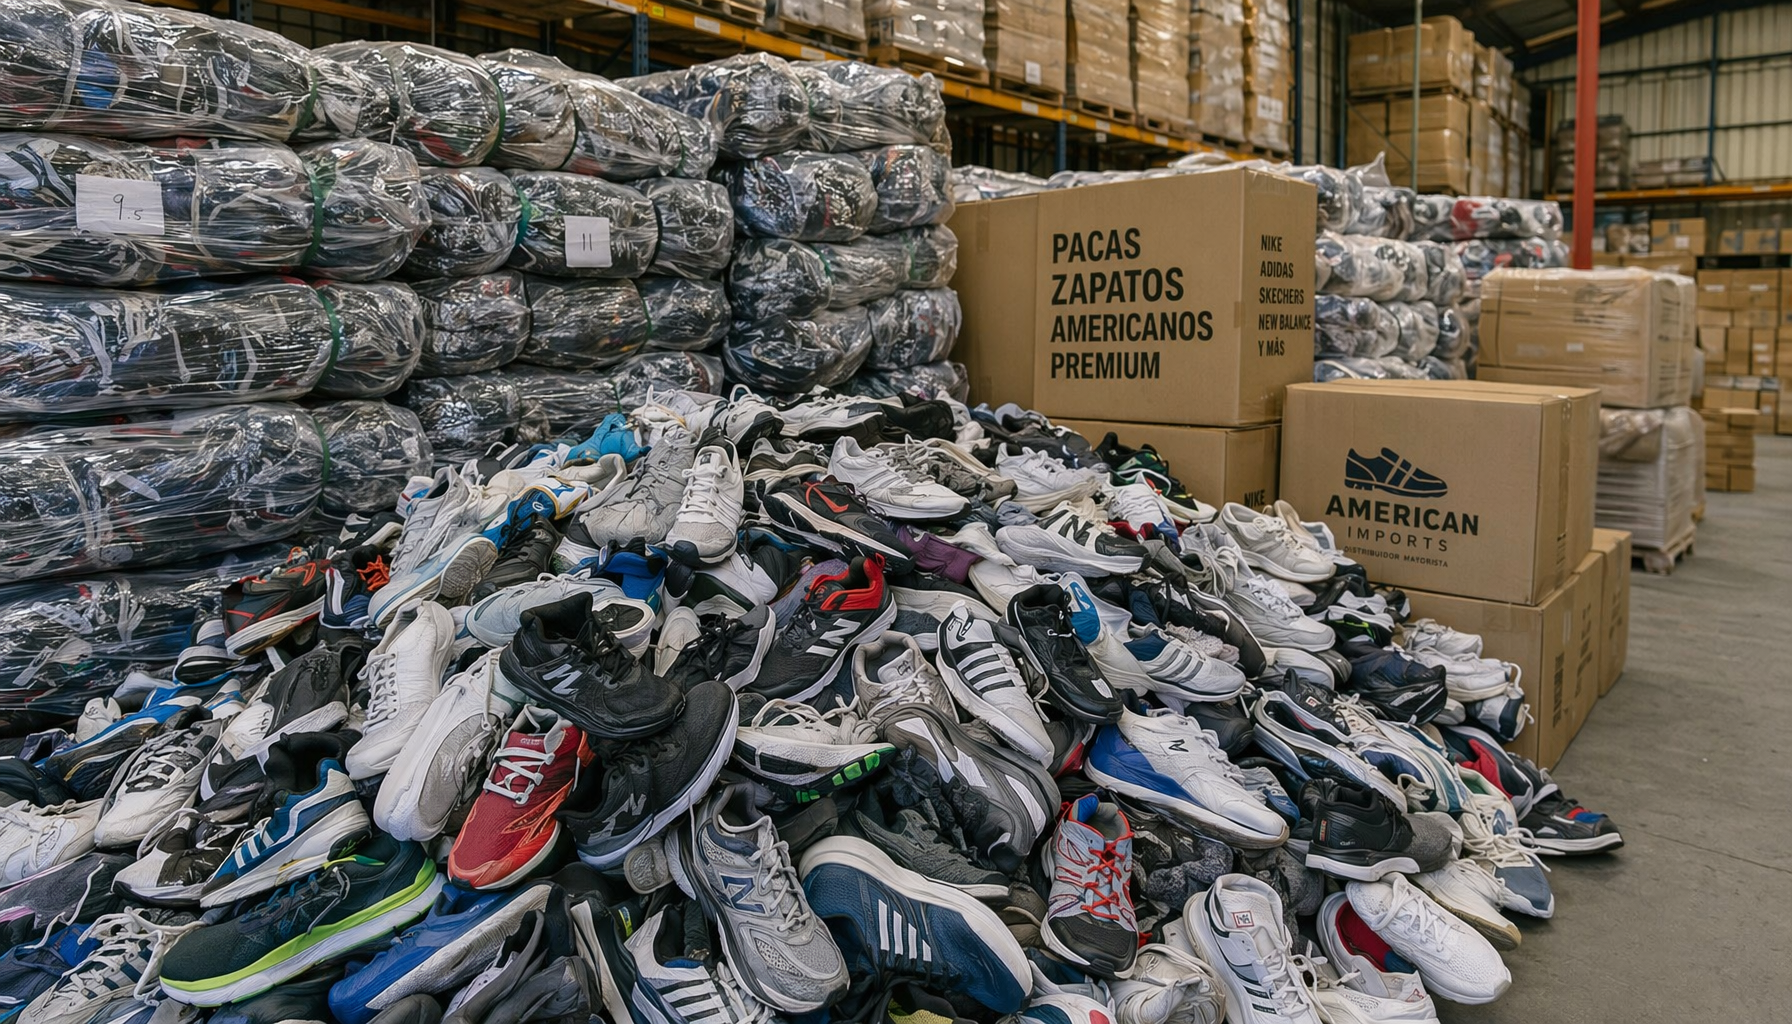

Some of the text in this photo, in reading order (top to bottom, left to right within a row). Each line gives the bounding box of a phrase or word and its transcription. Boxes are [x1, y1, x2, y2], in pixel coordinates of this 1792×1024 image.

[112, 193, 144, 221] 9.5
[1052, 228, 1141, 264] PACAS
[1260, 234, 1283, 253] NIKE
[1260, 261, 1294, 279] ADIDAS
[1051, 267, 1184, 306] ZAPATOS
[1258, 287, 1305, 305] SKECHERS
[1050, 311, 1214, 343] AMERICANOS
[1258, 314, 1312, 331] NEW BALANCE
[1258, 336, 1285, 358] Y MÁS
[1051, 352, 1161, 380] PREMIUM
[1244, 489, 1266, 509] NIKE
[1325, 494, 1480, 537] AMERICAN
[1347, 526, 1448, 552] IMPORTS
[1344, 545, 1448, 568] DISTRIBUIDOR MAYORISTA
